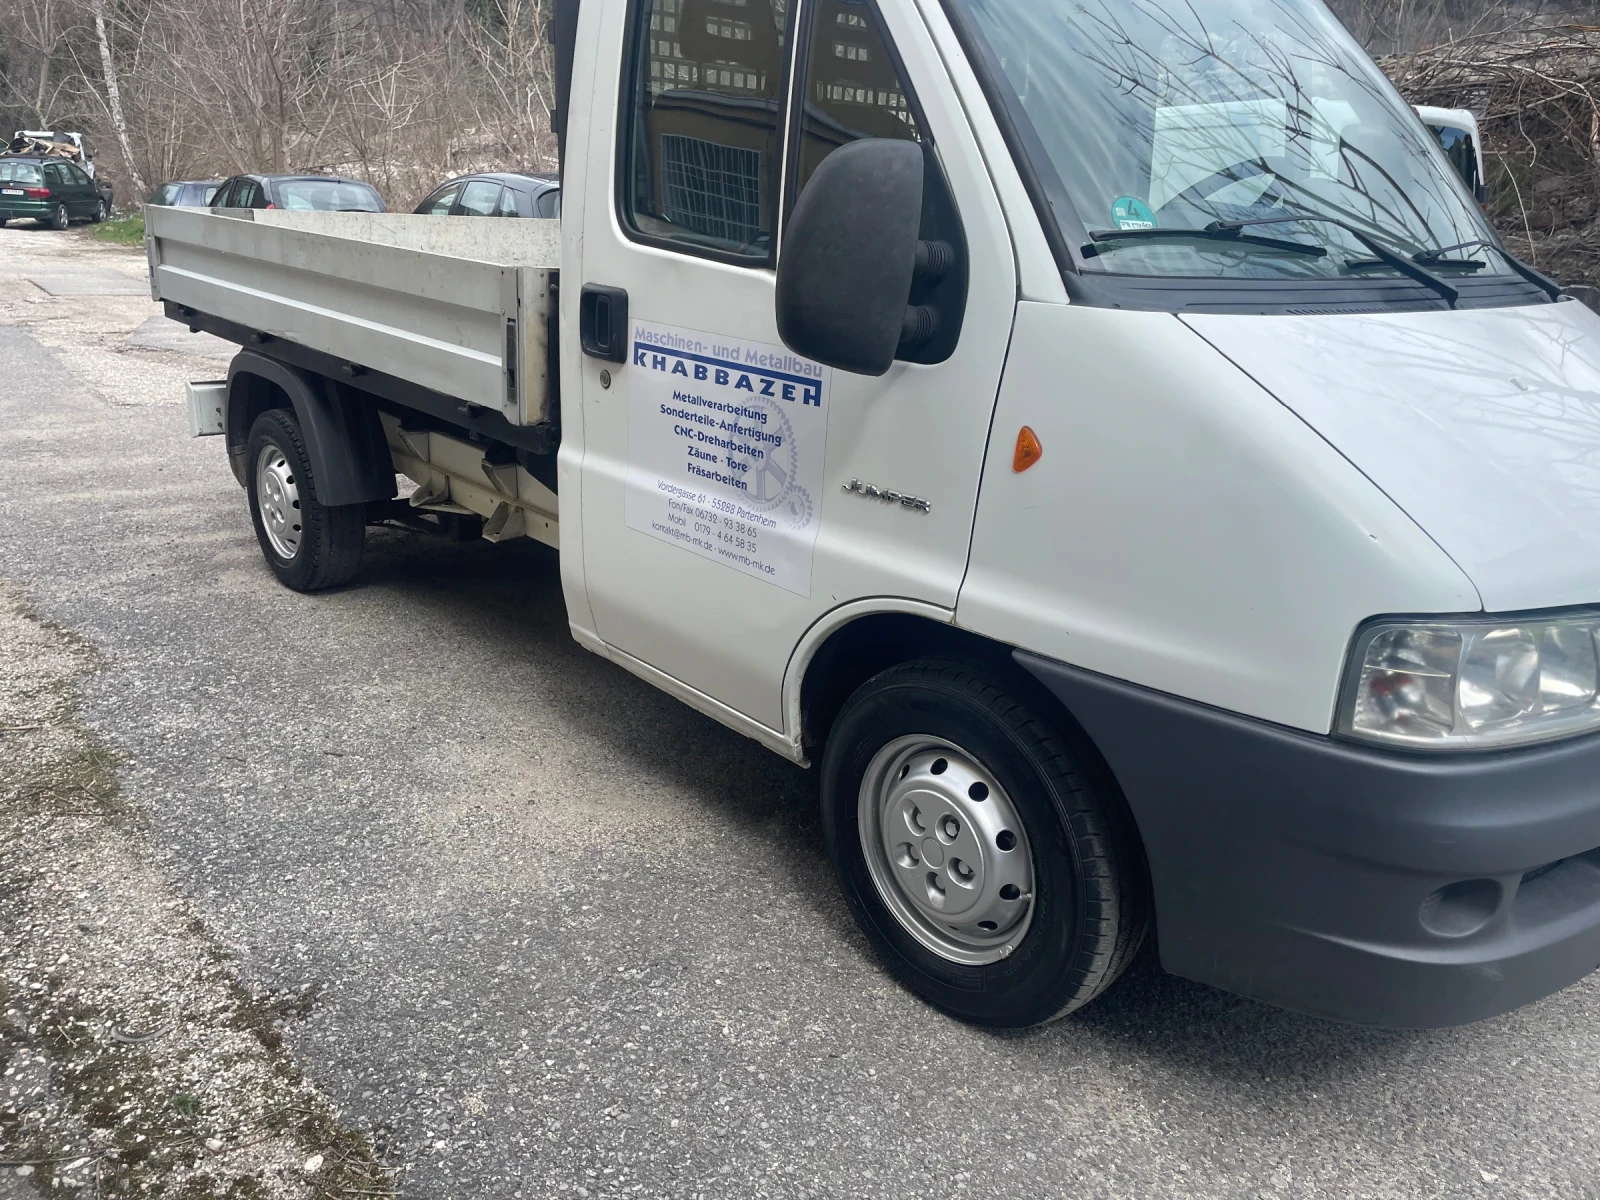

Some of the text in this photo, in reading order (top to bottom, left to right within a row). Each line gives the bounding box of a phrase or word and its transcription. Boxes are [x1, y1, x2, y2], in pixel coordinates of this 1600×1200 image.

[1128, 200, 1140, 218] 4
[634, 326, 822, 378] Maschinen- und Metallbau
[634, 343, 822, 407] KHABBAZEH
[660, 404, 782, 446] Sonderteile-Anfertigung
[672, 390, 768, 424] Metallverarbeitung
[674, 424, 764, 459] CNC-Dreharbeiten
[688, 446, 718, 464] Zäune
[726, 457, 748, 472] Tore
[688, 462, 748, 490] Fräsarbeiten
[842, 477, 931, 512] JUMPER
[658, 480, 696, 501] Vordergasse
[698, 494, 706, 504] 61
[711, 498, 735, 514] 55288
[736, 506, 776, 529] Partenheim
[668, 498, 694, 516] Fon/Fax
[695, 508, 717, 524] 06732
[724, 518, 734, 530] 93
[736, 523, 745, 534] 38
[747, 526, 757, 538] 65
[652, 520, 713, 552] kontakt@mb-mk.de
[718, 546, 776, 576] www.mb-mk.de
[668, 513, 686, 526] Mobil
[694, 522, 710, 536] 0179
[717, 531, 722, 539] 4
[724, 533, 733, 544] 64
[736, 538, 745, 549] 58
[747, 542, 757, 553] 35
